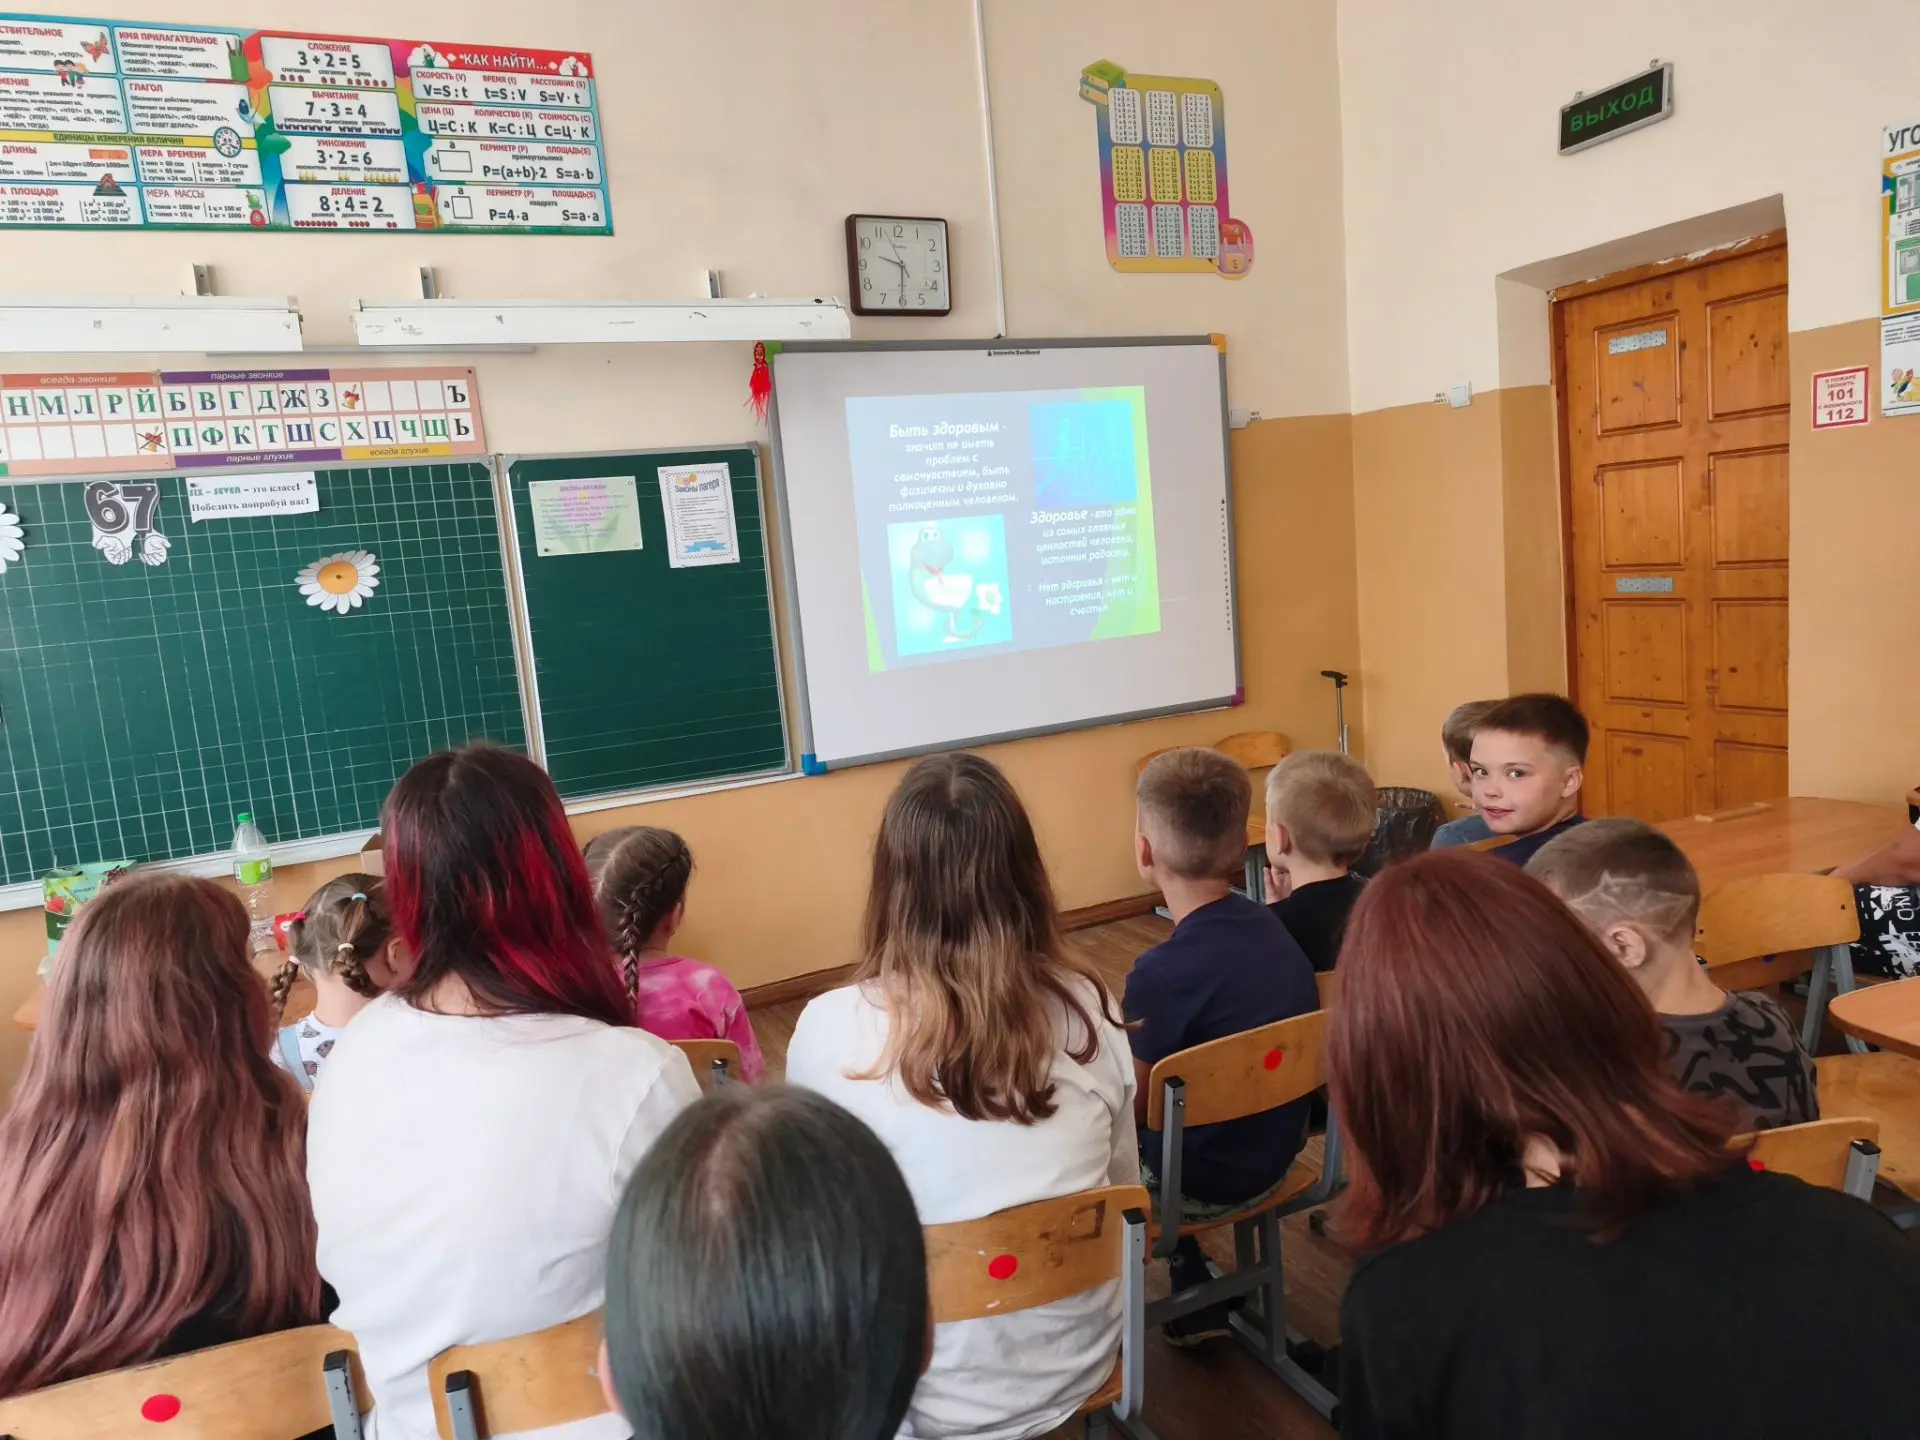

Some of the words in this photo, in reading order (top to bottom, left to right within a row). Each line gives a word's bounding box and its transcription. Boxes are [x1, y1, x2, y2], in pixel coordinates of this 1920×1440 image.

[119, 31, 139, 40] ИМЯ
[141, 33, 218, 45] ПРИЛАГАТЕЛЬНОЕ
[307, 42, 352, 52] СЛОЖЕНИЕ
[298, 51, 307, 66] 3
[324, 53, 335, 68] 2
[351, 55, 361, 69] 5
[416, 71, 454, 81] СКОРОСТЬ
[483, 75, 506, 84] ВРЕМЯ
[129, 83, 163, 92] ГЛАГОЛ
[531, 78, 574, 88] РАССТОЯНИЕ
[312, 91, 359, 100] ВЫЧИТАНИЕ
[306, 102, 314, 116] 7
[331, 102, 340, 117] 3
[358, 104, 367, 118] 4
[421, 107, 441, 115] ЦЕНА
[474, 109, 520, 118] КОЛИЧЕСТВО
[1570, 85, 1654, 133] ВЫХОД
[539, 112, 580, 122] СТОИМОСТЬ
[54, 133, 95, 142] ЕДИНИЦЫ
[97, 135, 145, 143] ИЗМЕРЕНИЯ
[147, 137, 184, 145] ВЕЛИЧИН
[317, 139, 366, 148] УМНОЖЕНИЕ
[2, 146, 37, 154] ДЛИНЫ
[167, 150, 206, 158] ВРЕМЕНИ
[480, 144, 516, 153] ПЕРИМЕТР
[317, 150, 326, 164] 3
[337, 150, 347, 164] 2
[363, 152, 372, 165] 6
[11, 187, 58, 197] ПЛОЩАДИ
[147, 189, 169, 197] МЕРА
[175, 190, 205, 198] МАССЫ
[332, 187, 366, 196] ДЕЛЕНИЕ
[486, 189, 521, 198] ПЕРИМЕТР
[320, 196, 330, 211] 8
[345, 196, 355, 211] 4
[373, 197, 383, 212] 2
[893, 225, 904, 238] 12
[860, 237, 871, 250] 10
[928, 238, 936, 252] 2
[859, 259, 867, 271] 9
[933, 260, 941, 273] 3
[863, 277, 872, 291] 8
[930, 280, 938, 291] 4
[880, 293, 887, 305] 7
[918, 293, 925, 306] 5
[40, 375, 75, 385] всегда
[78, 374, 117, 384] звонкие
[211, 372, 246, 381] парные
[248, 370, 284, 379] звонкие
[6, 396, 31, 416] Н
[37, 396, 64, 416] М
[74, 395, 94, 414] Л
[107, 394, 123, 414] Р
[137, 389, 156, 413] Й
[169, 393, 187, 411] Б
[200, 392, 216, 410] В
[228, 390, 244, 410] Г
[257, 390, 277, 413] Д
[281, 389, 308, 408] Ж
[315, 389, 330, 407] З
[447, 385, 466, 403] Ъ
[1827, 388, 1853, 401] 101
[1826, 408, 1854, 421] 112
[172, 428, 192, 447] П
[202, 427, 224, 445] Ф
[233, 426, 252, 445] К
[262, 424, 279, 443] Т
[286, 423, 313, 442] Ш
[320, 422, 337, 441] С
[345, 421, 366, 440] Х
[373, 421, 394, 442] Ц
[400, 419, 417, 438] Ч
[422, 419, 449, 439] Щ
[454, 418, 470, 436] Ь
[889, 424, 929, 438] Быть
[932, 421, 999, 437] здоровым
[370, 448, 399, 457] всегда
[400, 446, 429, 456] глухие
[905, 442, 944, 452] значит
[946, 442, 958, 450] не
[961, 439, 994, 449] иметь
[226, 454, 261, 464] парные
[263, 452, 294, 462] глухие
[925, 454, 970, 467] проблем
[982, 466, 1010, 476] быть
[85, 481, 159, 532] 67
[191, 503, 239, 512] Победить
[242, 499, 287, 509] попробуй
[888, 498, 960, 512] полноценным
[1030, 510, 1088, 524] Здоровье
[1056, 525, 1085, 536] самых
[1039, 582, 1059, 593] Нет
